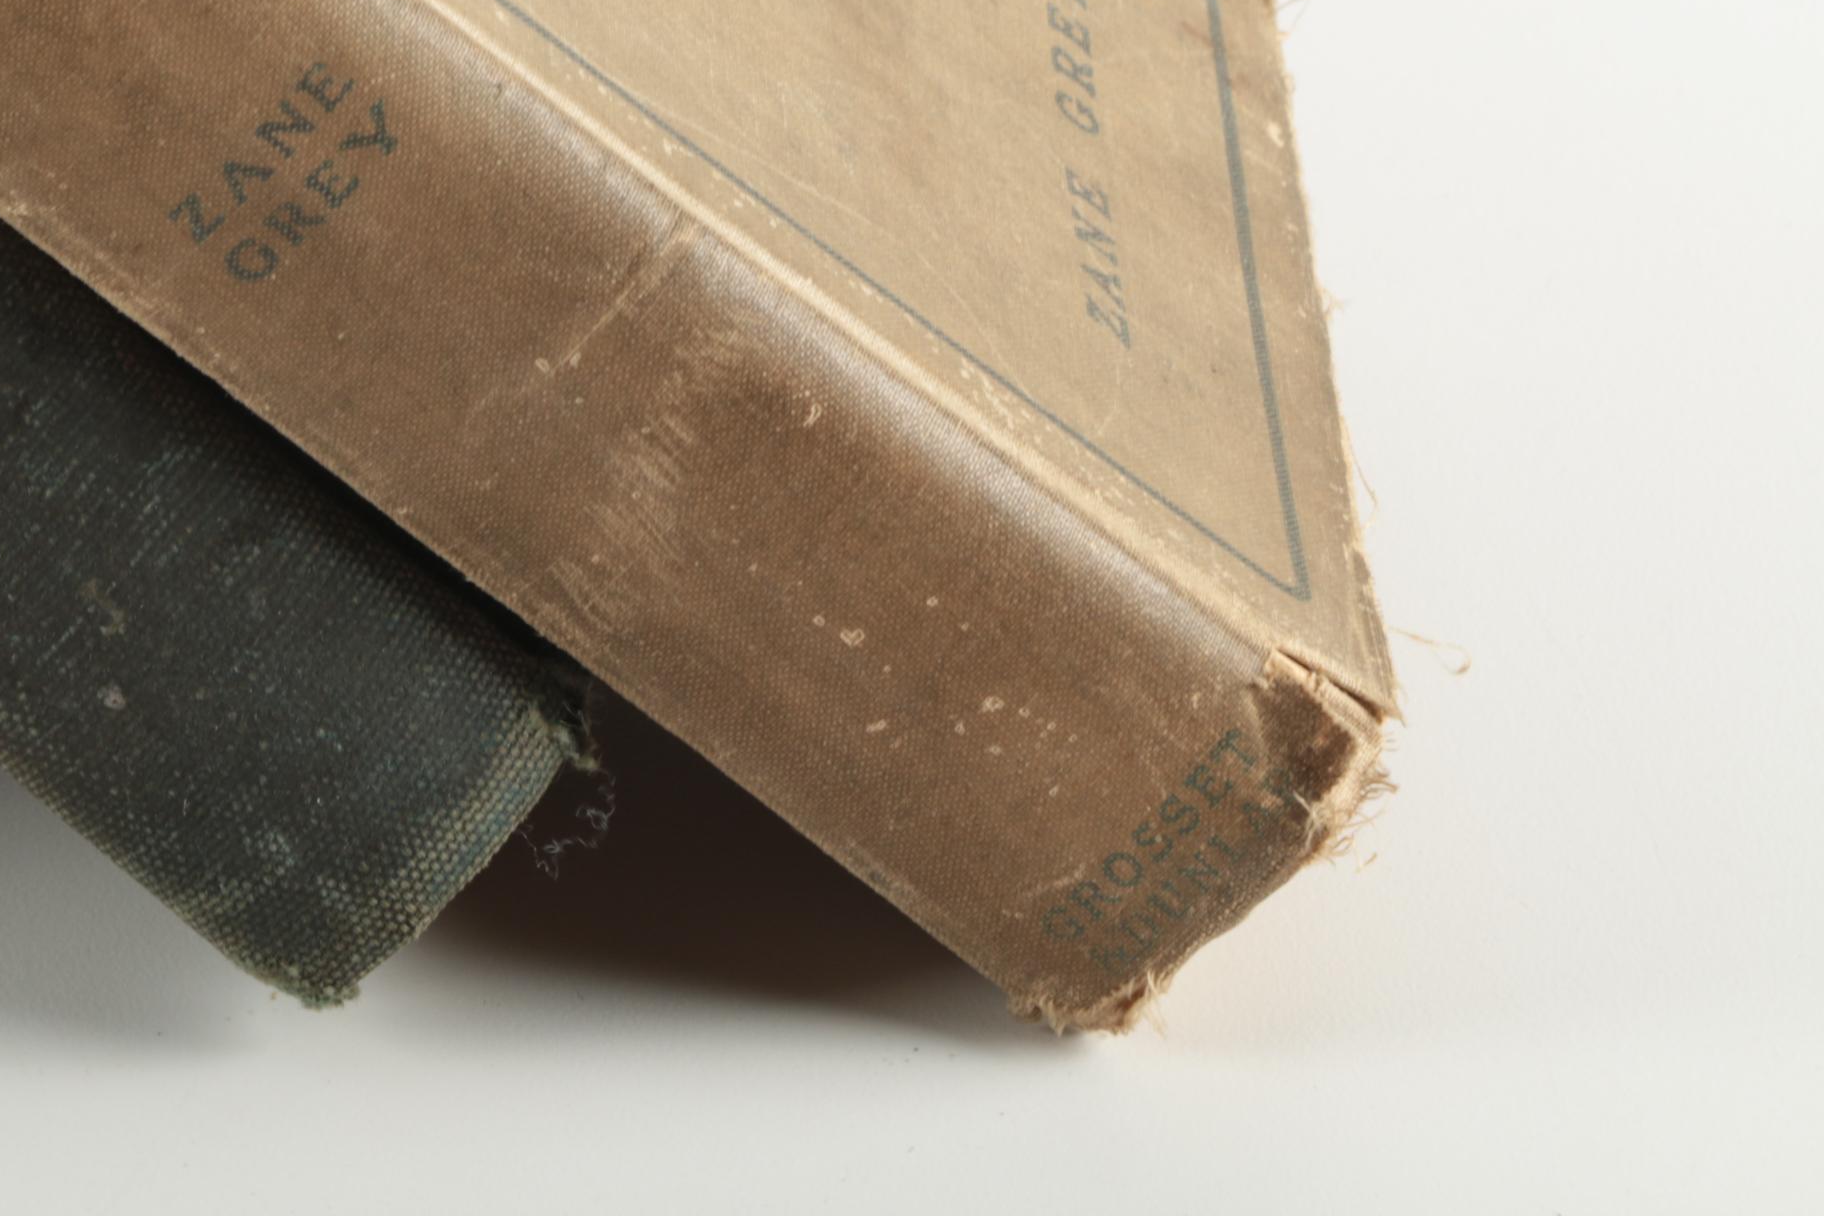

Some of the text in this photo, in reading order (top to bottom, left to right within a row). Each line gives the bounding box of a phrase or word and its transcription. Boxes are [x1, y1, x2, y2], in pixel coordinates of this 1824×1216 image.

[167, 62, 355, 245] ZANE
[226, 99, 398, 281] GREY
[1066, 165, 1131, 350] ZANE
[1042, 729, 1256, 941] GROSSET
